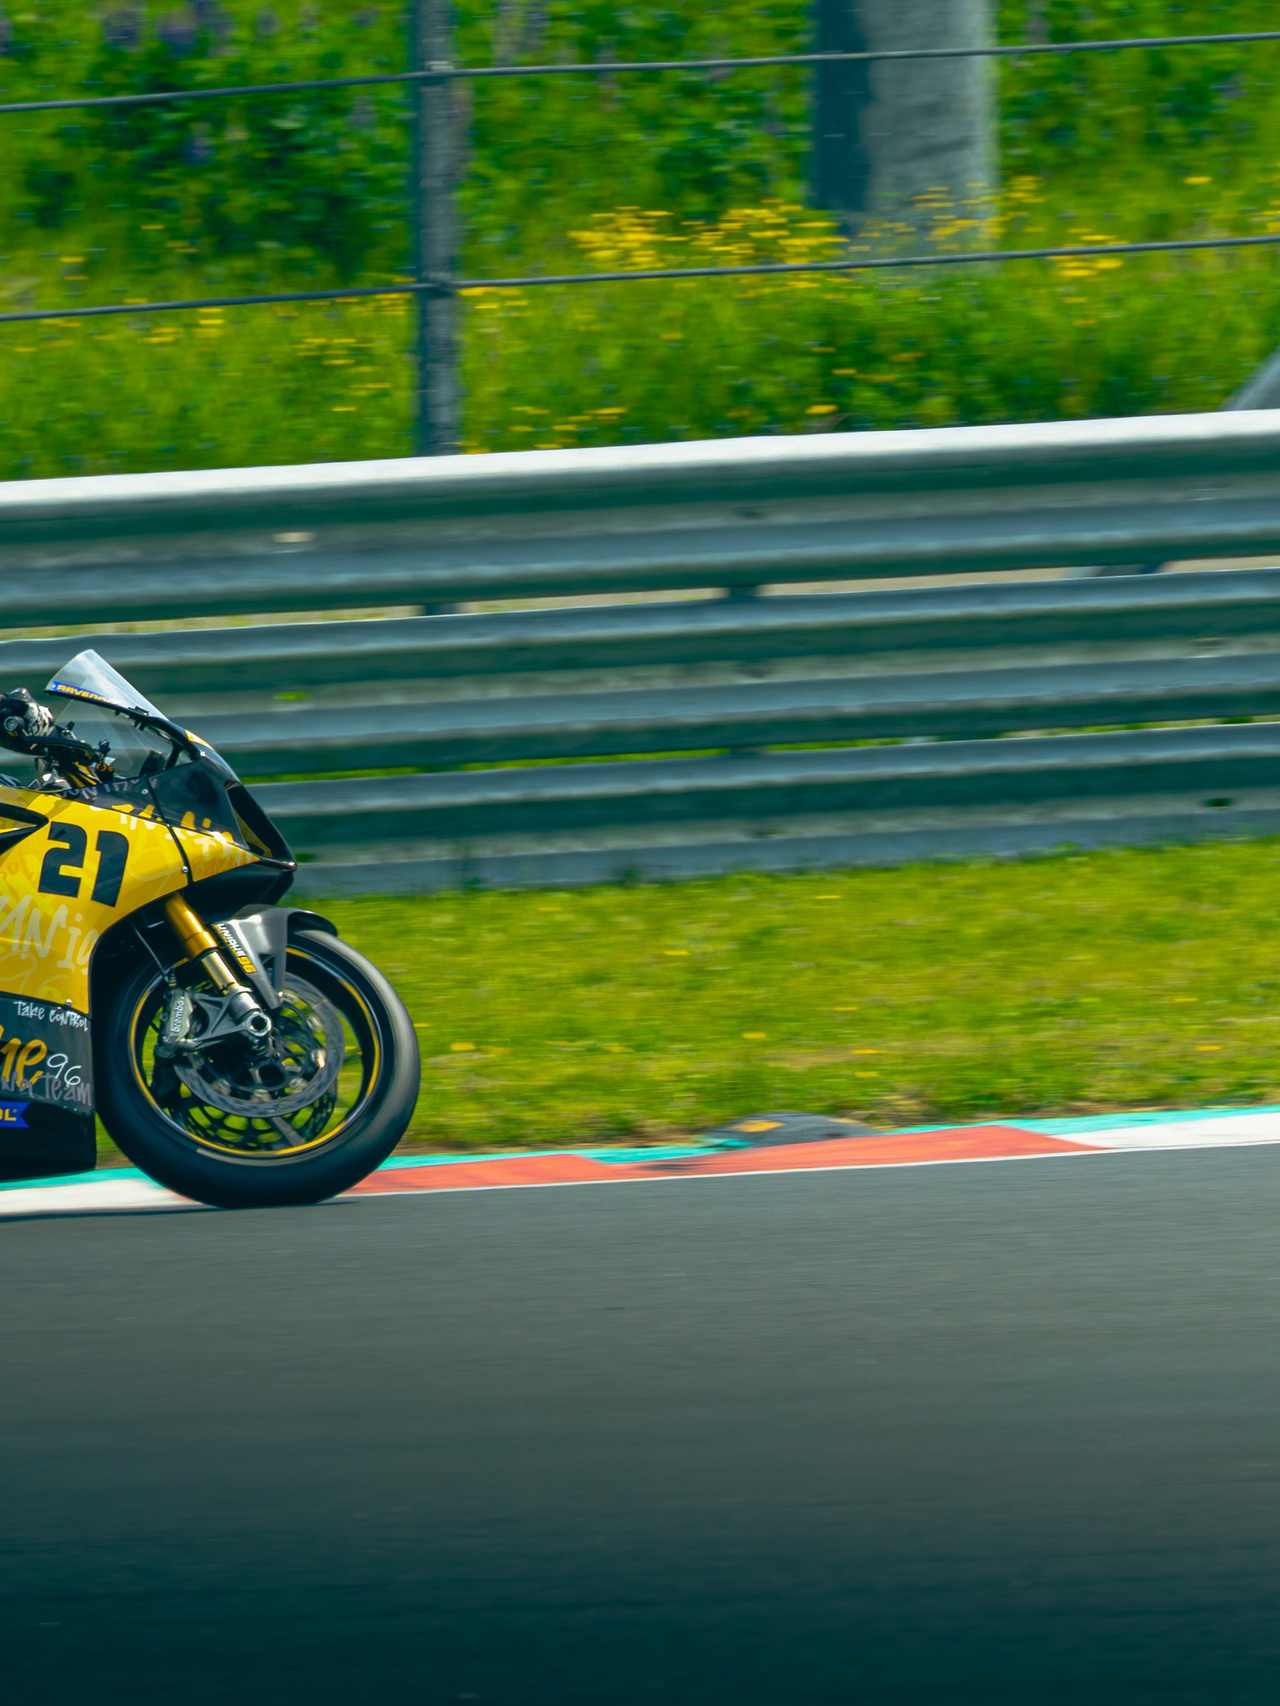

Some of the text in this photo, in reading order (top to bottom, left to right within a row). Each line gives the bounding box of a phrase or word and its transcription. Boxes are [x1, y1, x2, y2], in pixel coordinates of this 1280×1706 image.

[37, 820, 130, 908] 21
[13, 1001, 45, 1020] Take
[47, 1053, 82, 1087] 96
